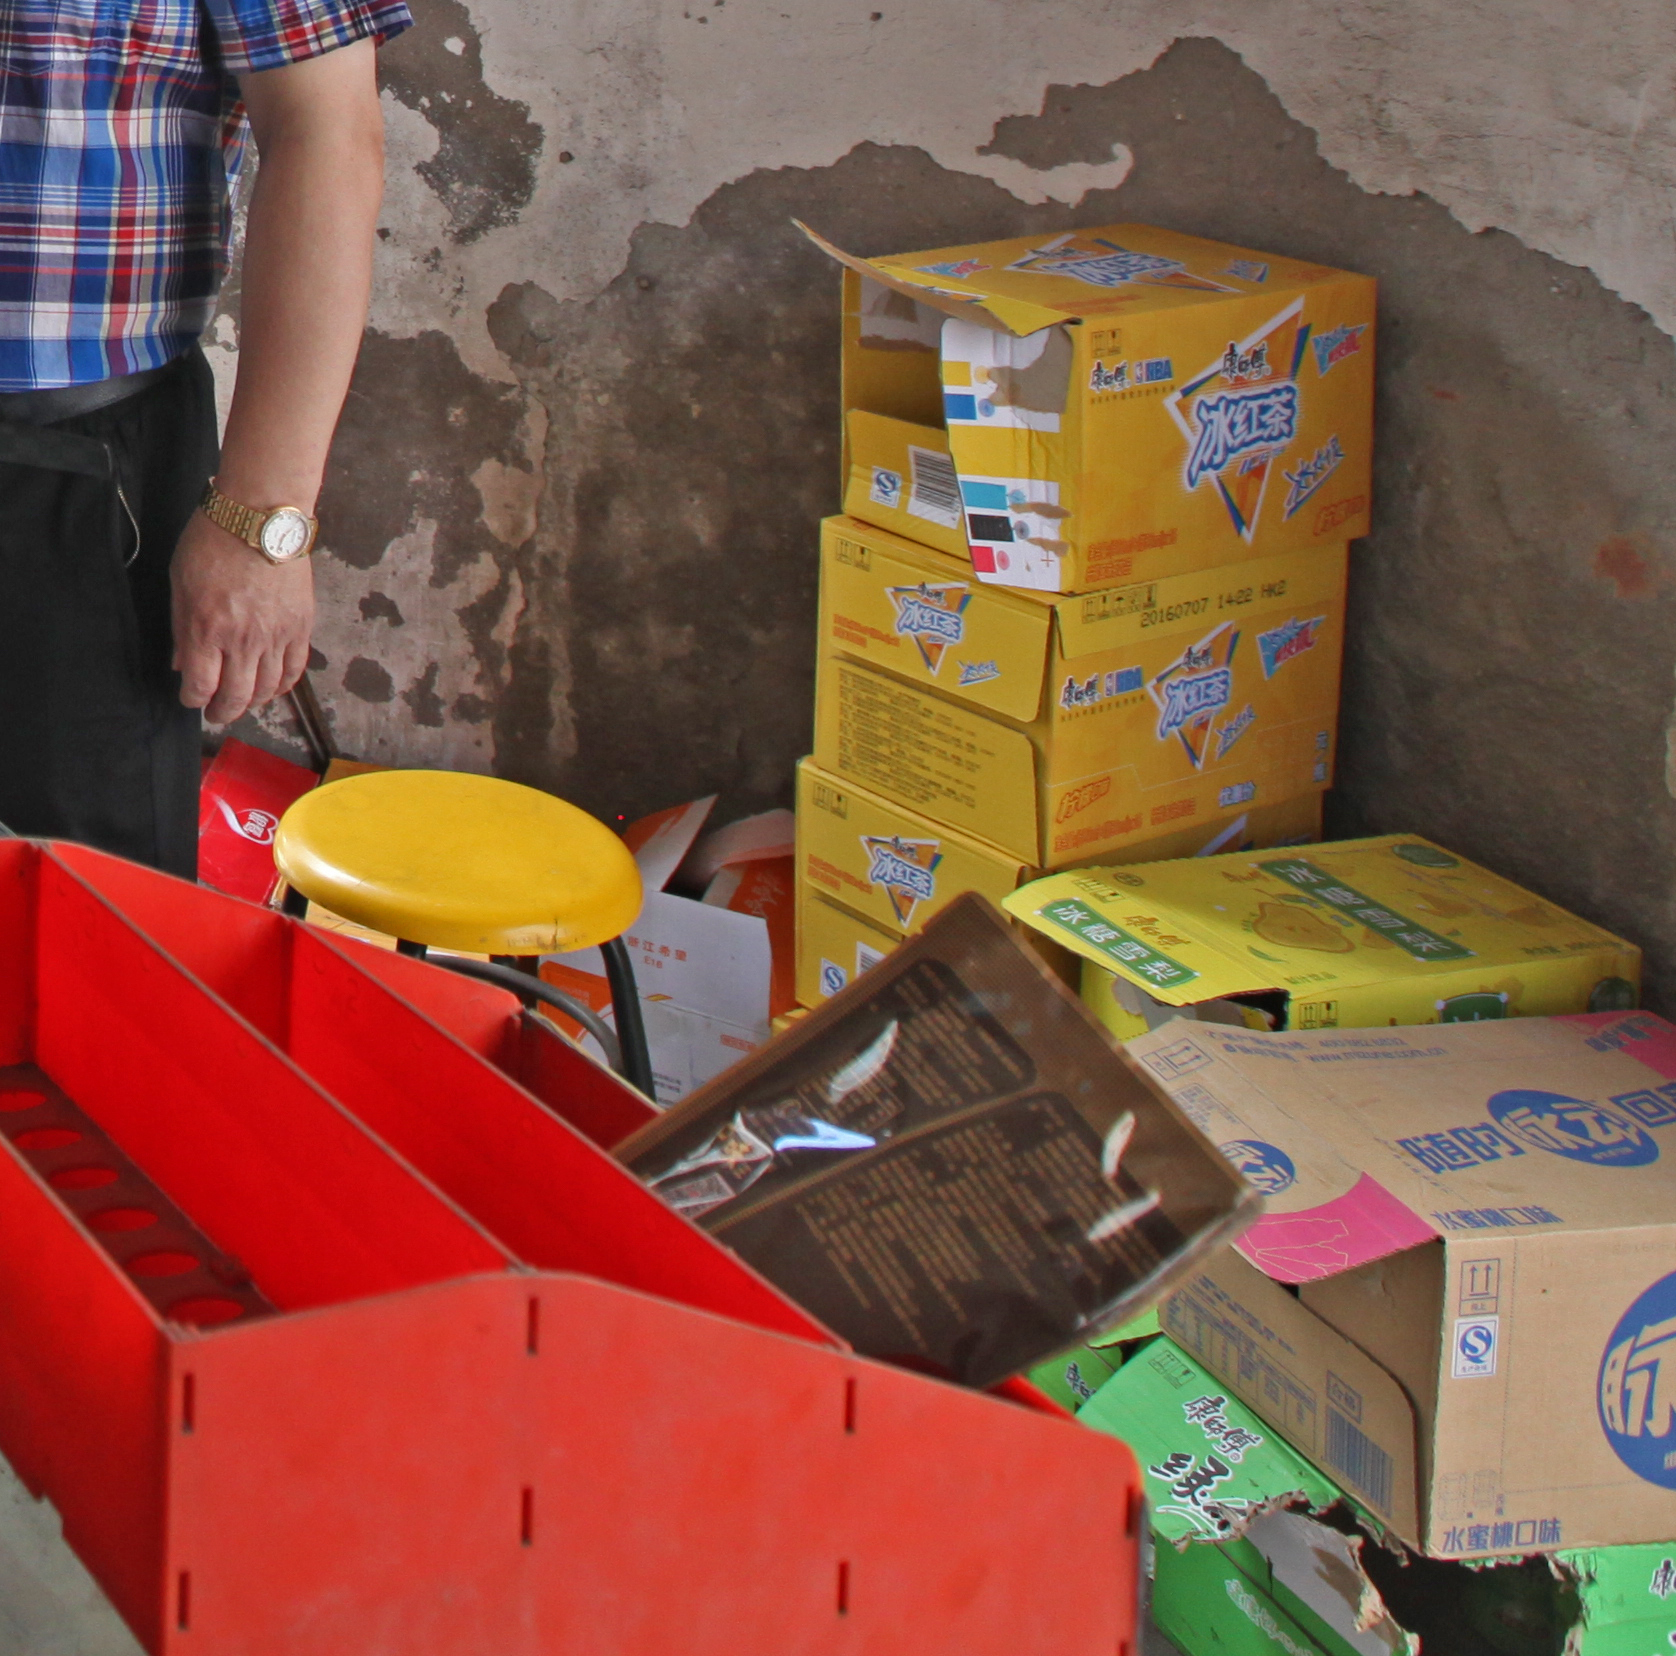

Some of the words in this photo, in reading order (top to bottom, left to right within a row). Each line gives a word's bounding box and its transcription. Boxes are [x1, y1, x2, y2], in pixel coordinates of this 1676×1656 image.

[1186, 383, 1298, 491] 冰红茶
[897, 597, 963, 643] 冰红茶
[1140, 597, 1209, 628] 20160707
[1217, 587, 1254, 610] 1422
[1260, 579, 1287, 596] HK2
[1157, 668, 1232, 740] 冰红茶
[870, 848, 934, 897] 冰红茶
[1275, 864, 1452, 953] 冰糖雪梨
[627, 935, 688, 962] 浙江希望
[1052, 904, 1182, 982] 冰糖雪梨
[1395, 1121, 1527, 1175] 随时
[1430, 1205, 1565, 1231] 水蜜桃口味
[1442, 1517, 1562, 1555] 水蜜桃口味
